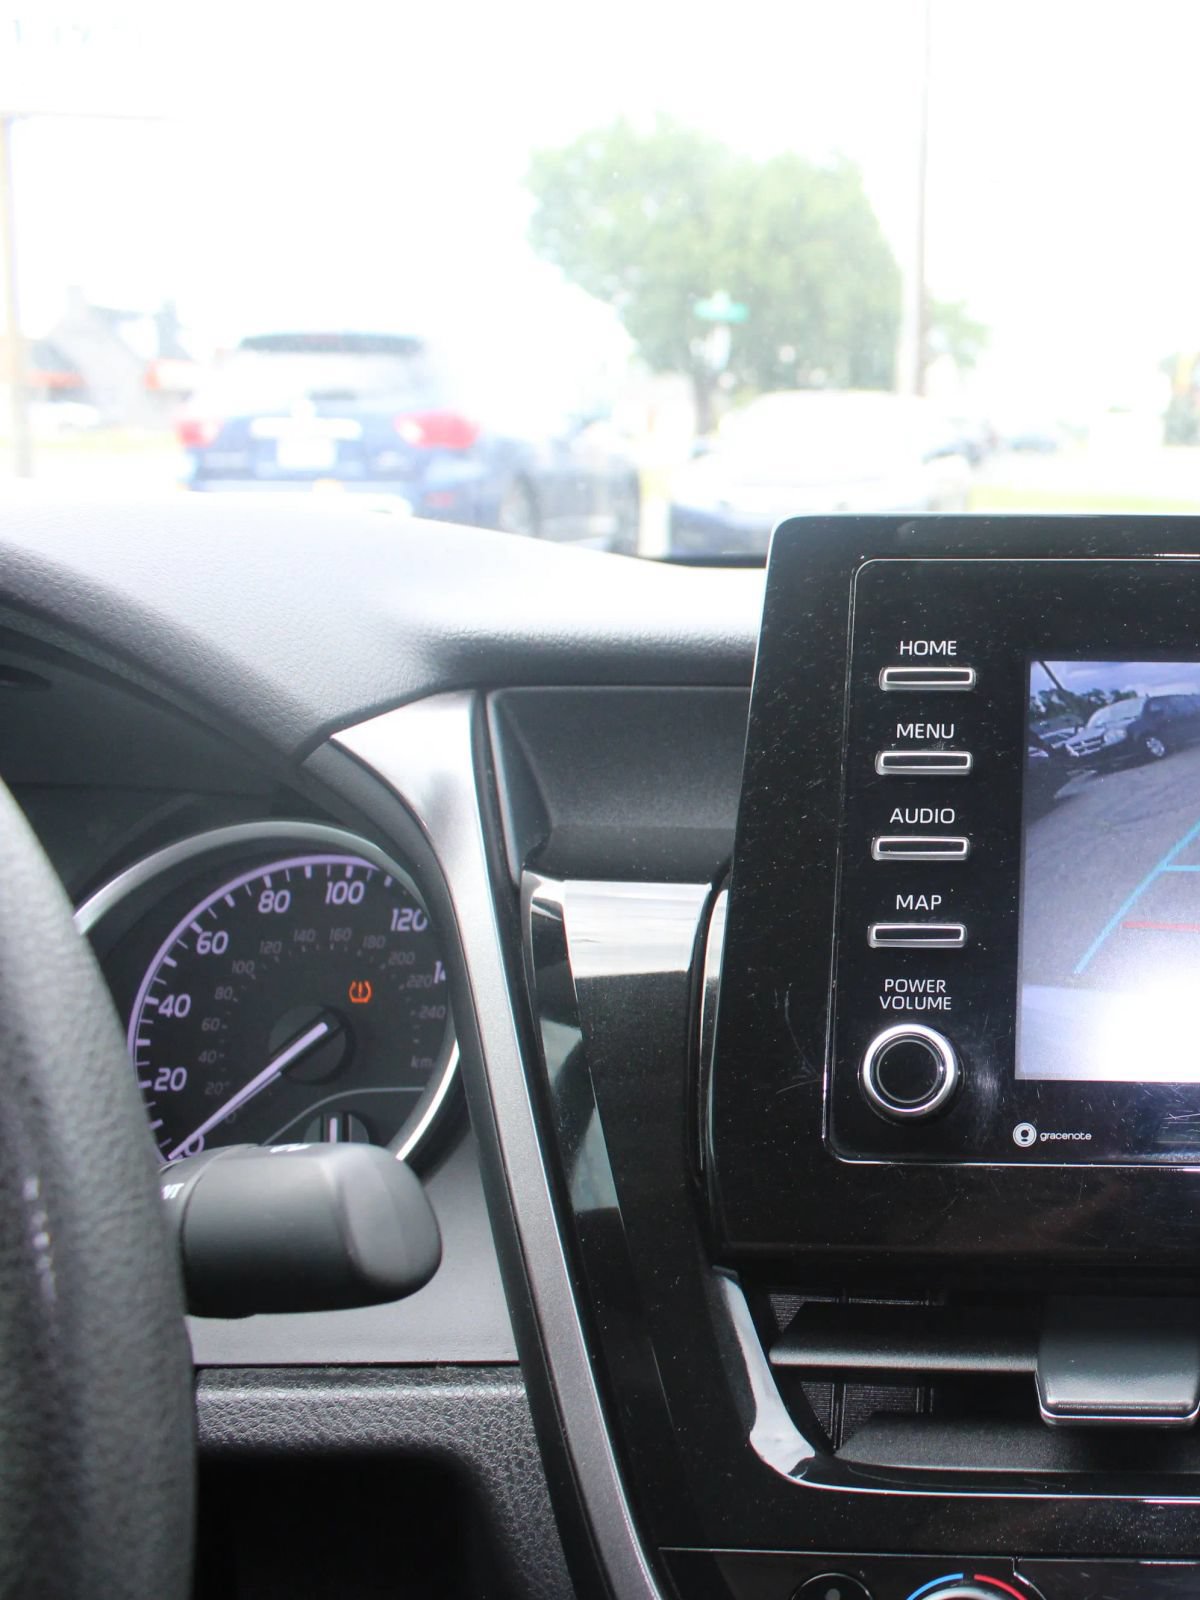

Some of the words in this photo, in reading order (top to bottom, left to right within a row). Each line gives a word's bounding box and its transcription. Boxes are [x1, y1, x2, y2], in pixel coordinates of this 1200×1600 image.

[900, 640, 958, 657] HOME
[896, 723, 955, 740] MENU
[890, 808, 955, 824] AUDIO
[326, 881, 366, 905] 100
[258, 889, 291, 914] 80
[896, 895, 942, 910] MAP
[391, 908, 427, 931] 120
[293, 929, 316, 942] 140
[329, 928, 352, 942] 160
[362, 935, 386, 948] 180
[196, 931, 228, 954] 60
[259, 941, 282, 954] 120
[388, 951, 415, 965] 200
[232, 960, 255, 975] 100
[407, 974, 433, 988] 220
[885, 979, 946, 993] POWER
[215, 986, 233, 1000] 80
[158, 994, 191, 1018] 40
[880, 996, 952, 1011] VOLUME
[419, 1005, 446, 1019] 240
[202, 1018, 220, 1032] 60
[198, 1050, 217, 1063] 40
[154, 1067, 187, 1091] 20
[1040, 1132, 1092, 1142] gracenote
